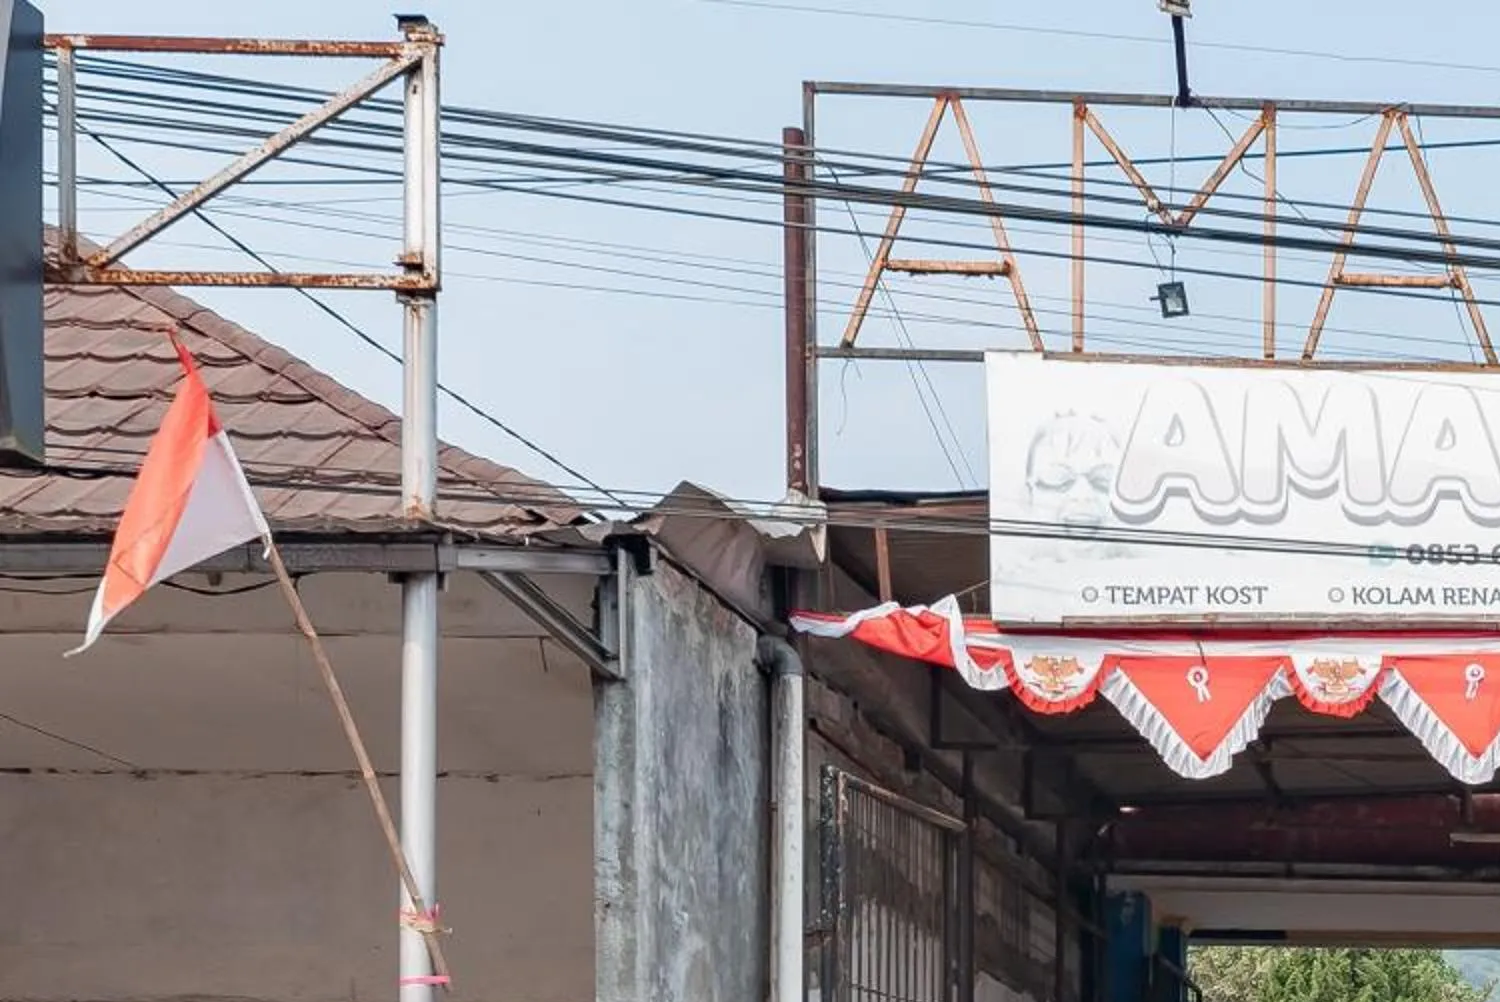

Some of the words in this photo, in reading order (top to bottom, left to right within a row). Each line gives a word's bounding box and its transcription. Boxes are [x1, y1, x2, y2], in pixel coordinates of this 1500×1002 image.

[1407, 543, 1480, 565] 0853
[1105, 585, 1199, 605] TEMPAT
[1205, 585, 1269, 605] KOST
[1352, 586, 1435, 606] KOLAM
